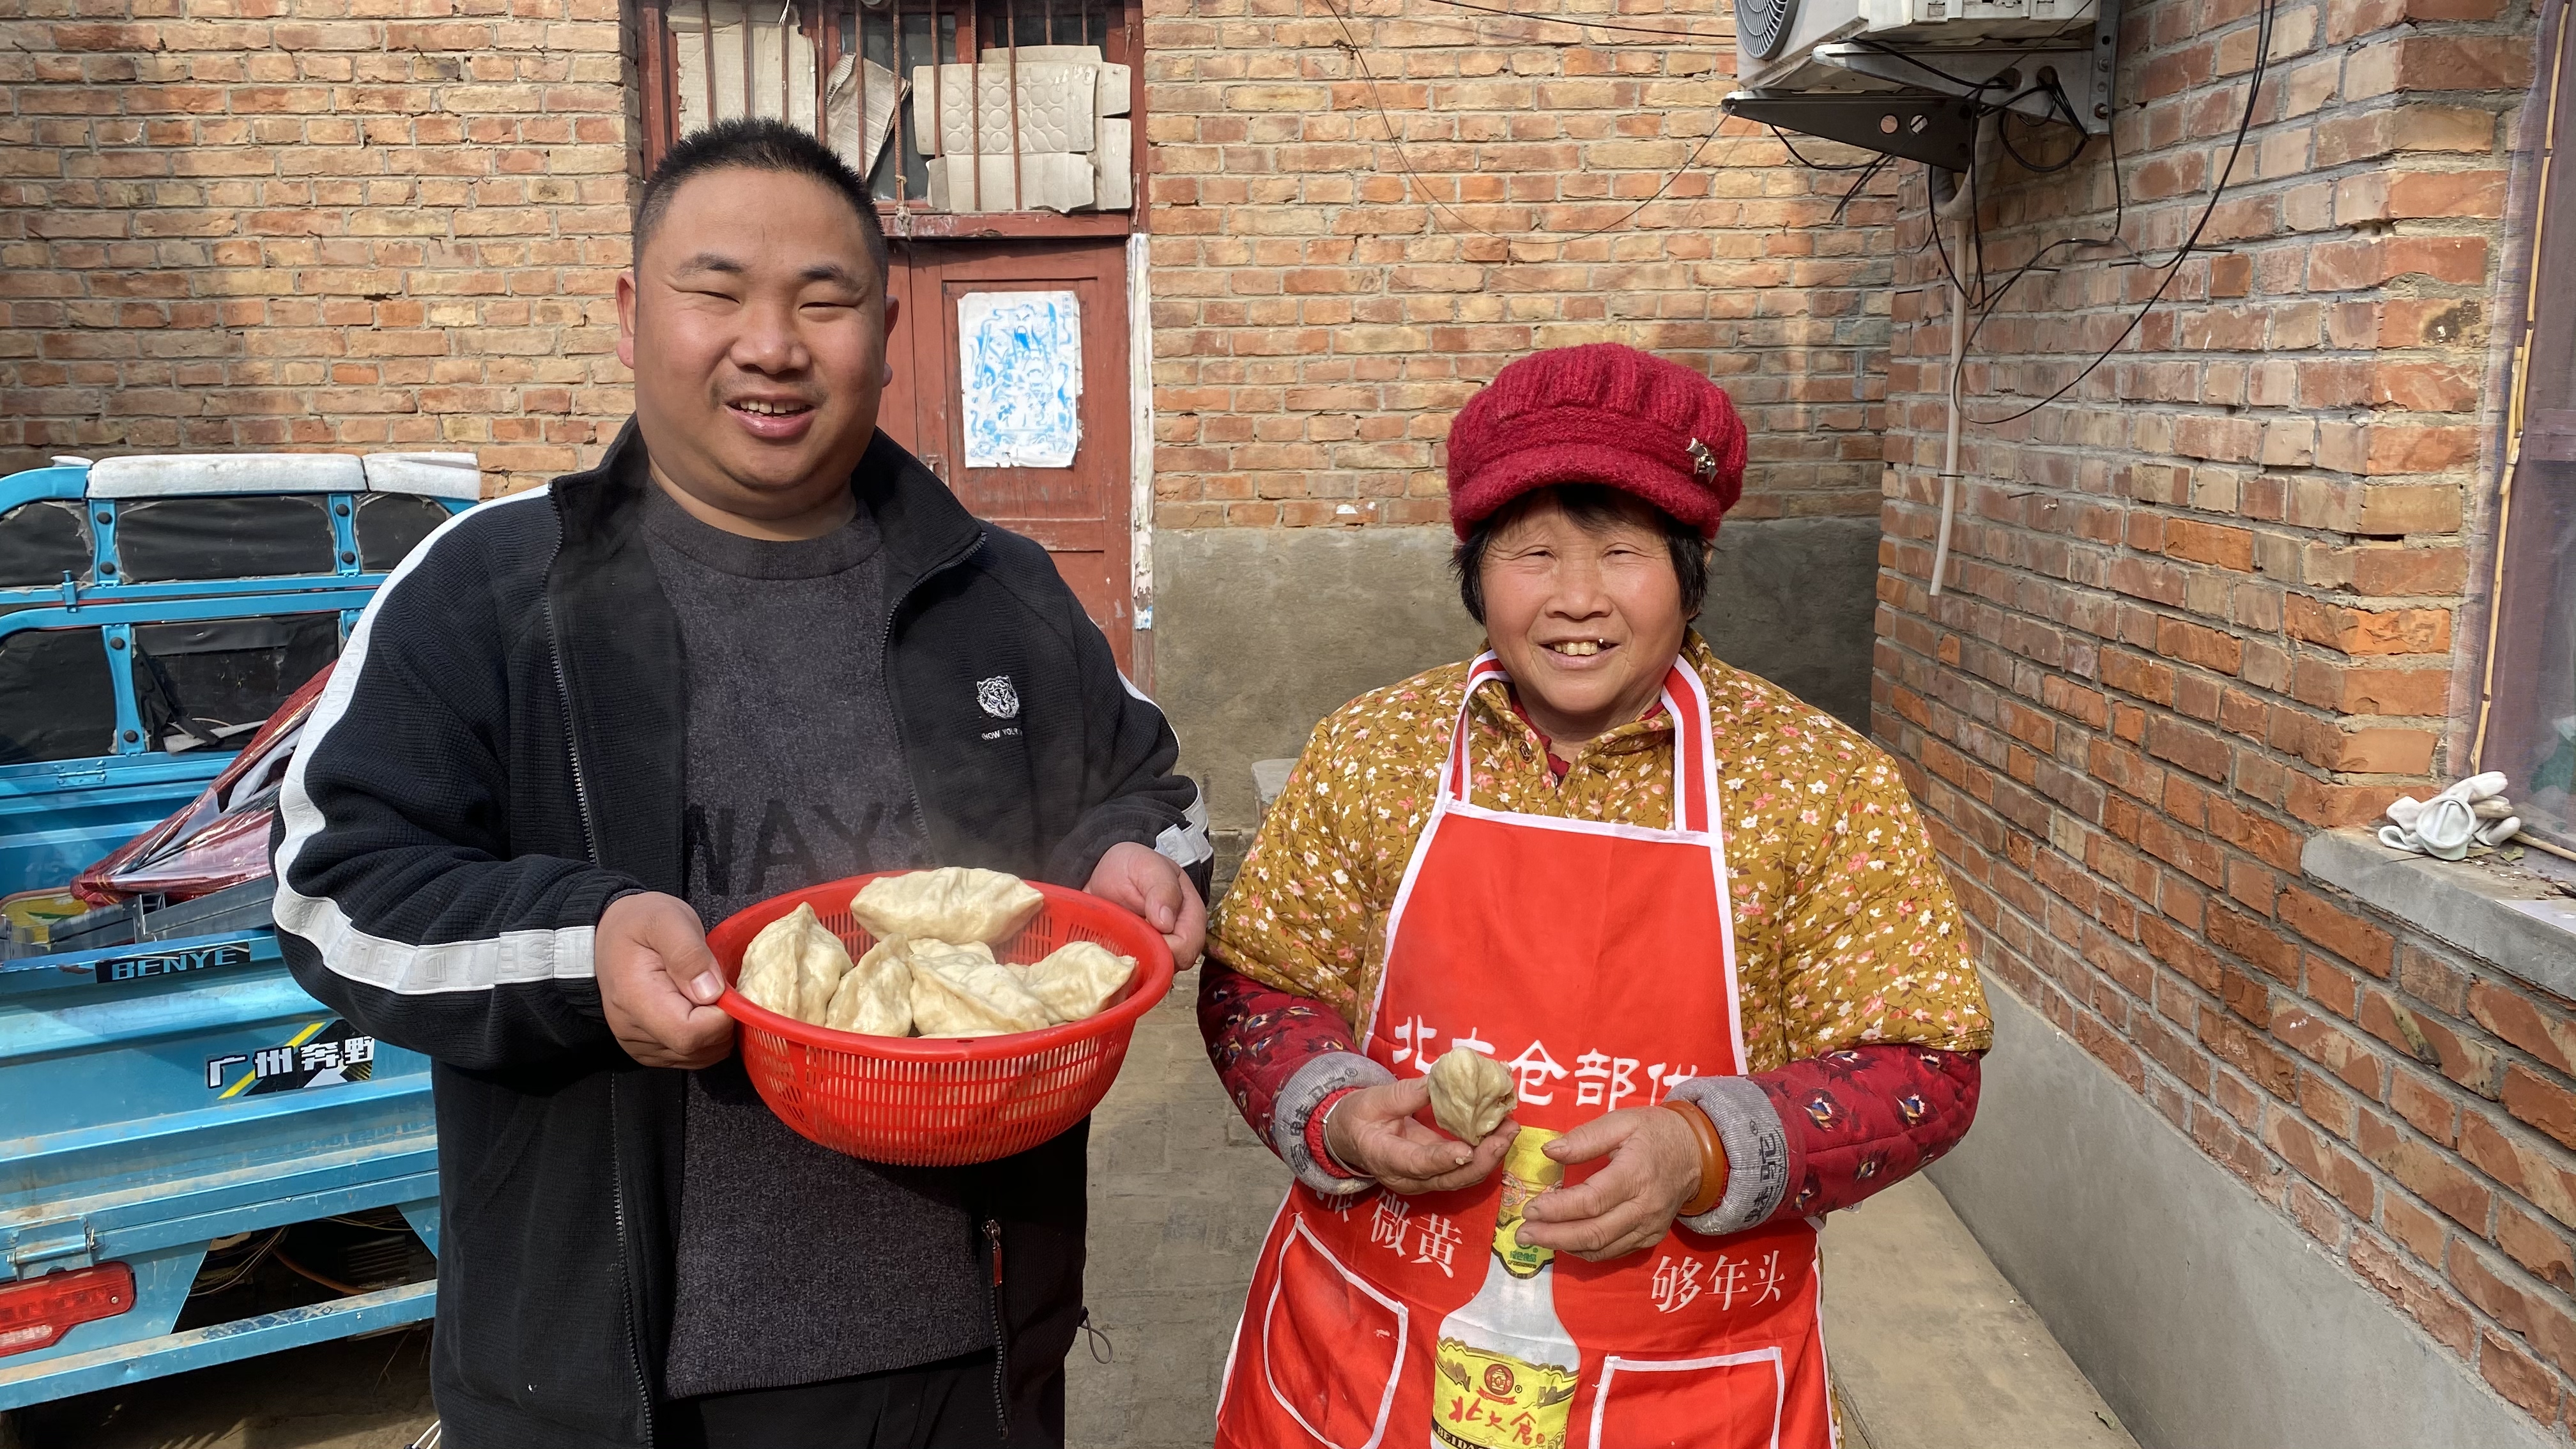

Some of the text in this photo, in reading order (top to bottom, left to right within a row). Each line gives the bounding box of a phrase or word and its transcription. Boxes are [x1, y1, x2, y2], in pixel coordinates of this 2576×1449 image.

[111, 948, 238, 981] BENYE
[209, 1036, 375, 1087] 广州奔野
[1316, 1189, 1463, 1278] 微黄
[1651, 1250, 1786, 1314] 够年头
[1437, 1425, 1491, 1449] BEID
